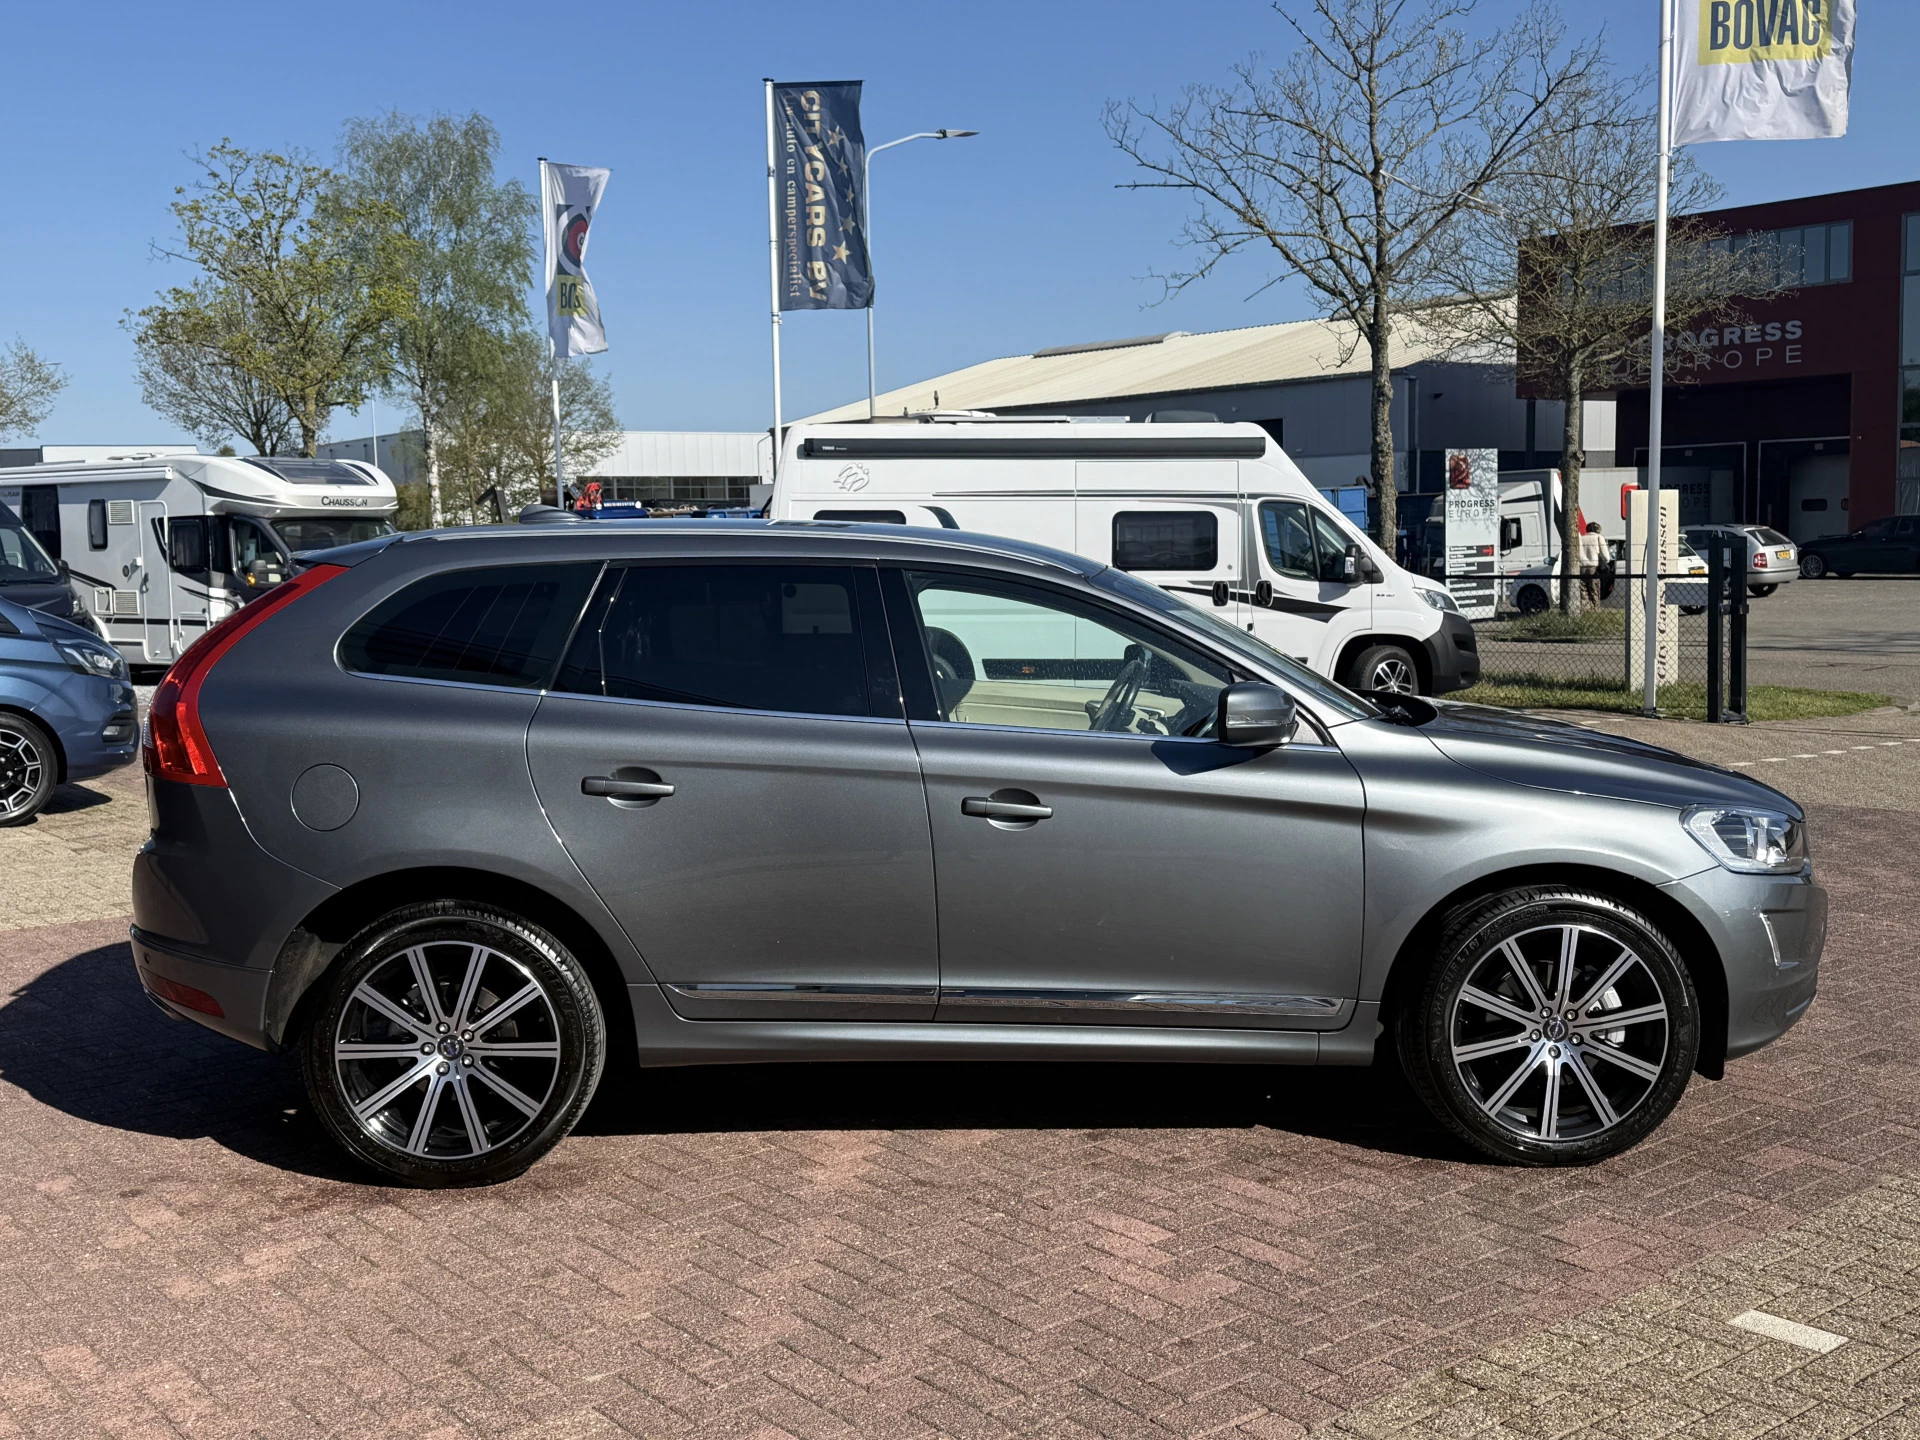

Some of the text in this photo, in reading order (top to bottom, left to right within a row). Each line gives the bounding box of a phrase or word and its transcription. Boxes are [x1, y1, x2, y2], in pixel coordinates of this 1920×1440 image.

[1710, 0, 1821, 51] BOVAG
[785, 121, 798, 153] auto
[786, 158, 797, 175] en
[785, 179, 802, 298] camperspecialist
[1449, 500, 1495, 509] PROGRESS
[1449, 508, 1495, 518] EUROPE
[1658, 506, 1668, 580] aassen
[1657, 645, 1669, 680] City
